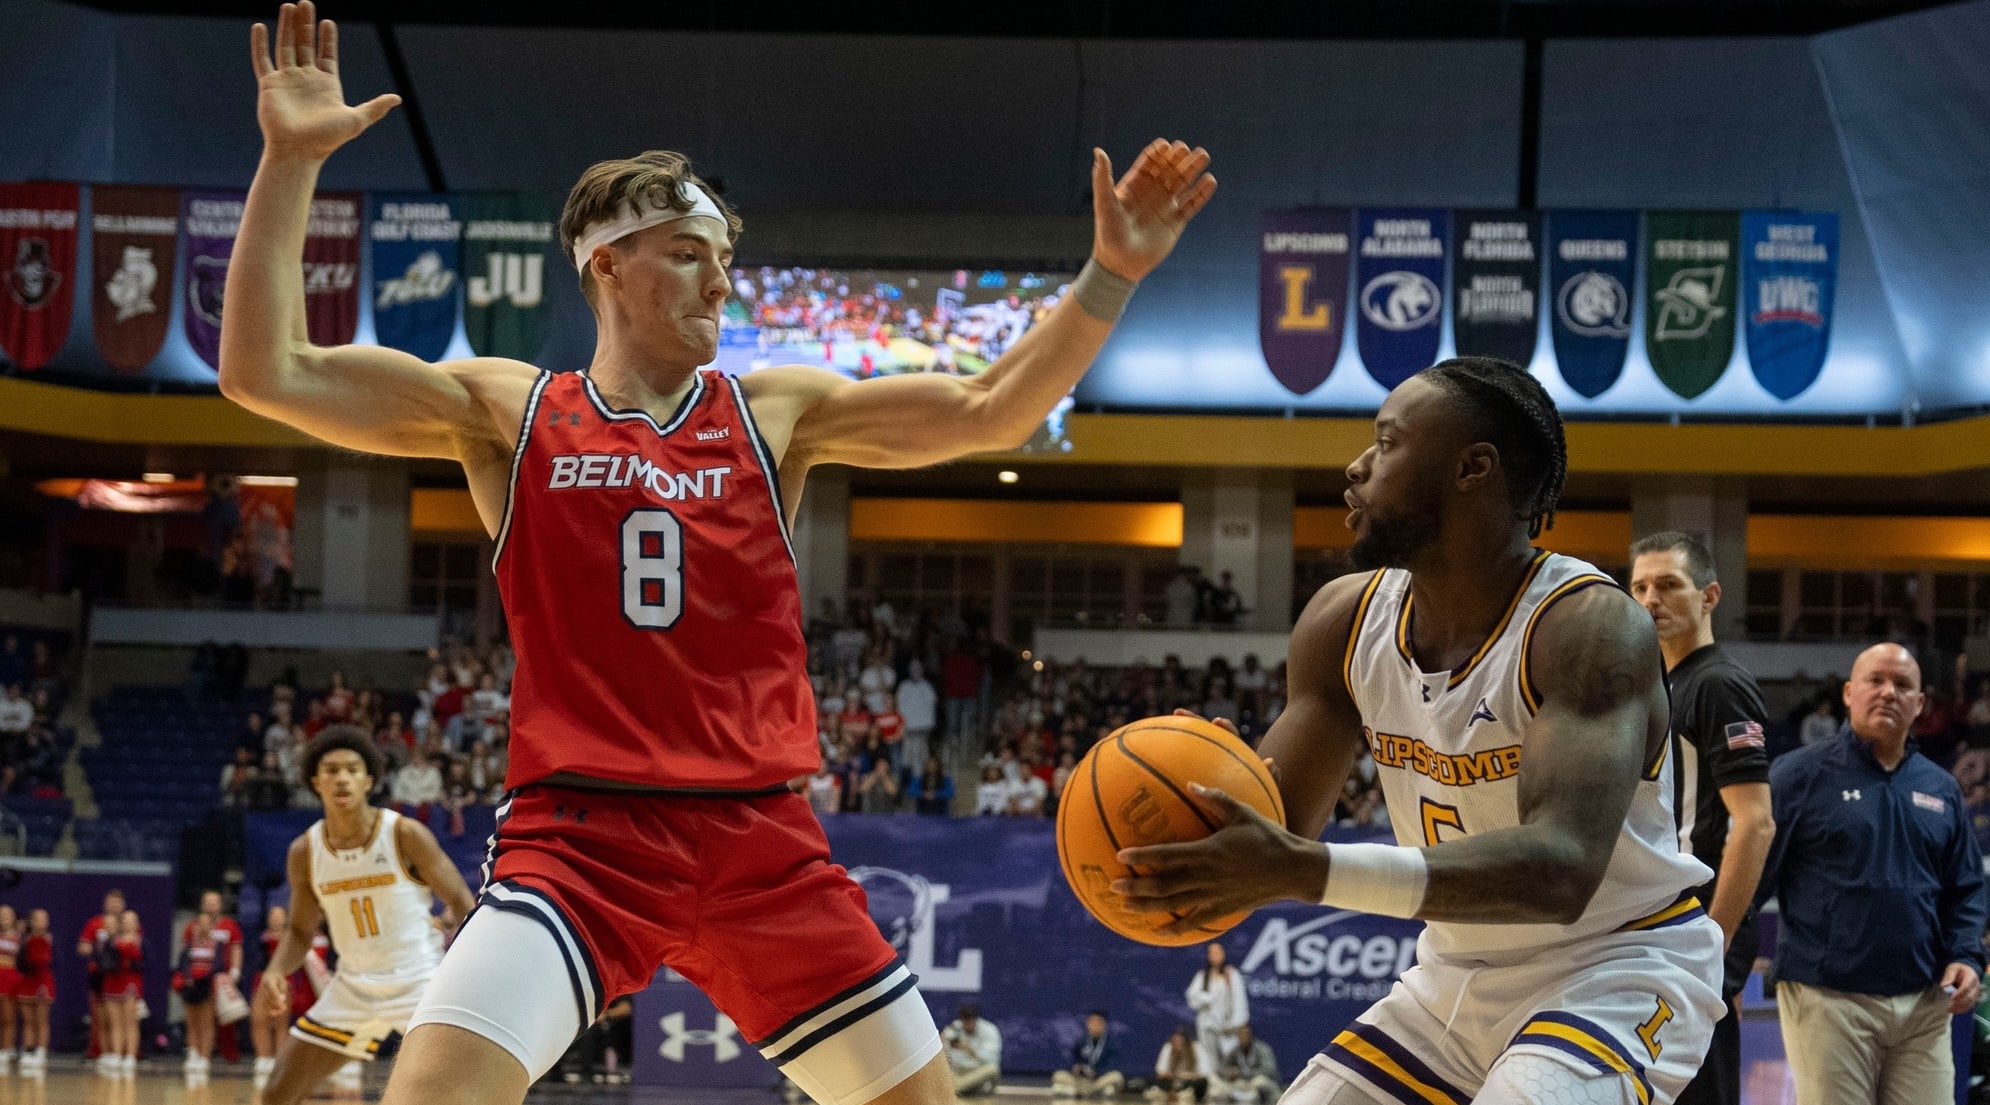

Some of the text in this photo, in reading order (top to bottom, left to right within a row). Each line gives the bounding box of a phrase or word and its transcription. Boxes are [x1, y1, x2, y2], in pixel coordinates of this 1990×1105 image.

[1373, 219, 1432, 237] NORTH
[1470, 222, 1528, 240] NORTH
[1263, 232, 1349, 253] LIPSCOMB
[1360, 237, 1443, 257] ALABAMA
[1462, 240, 1534, 260] FLORIDA
[1559, 239, 1627, 260] QUEENS
[468, 253, 544, 308] JU
[1277, 265, 1331, 332] L
[695, 426, 729, 441] VALLEY
[548, 453, 731, 501] BELMONT
[618, 507, 685, 630] 8
[1364, 726, 1522, 787] LIPSCOMB
[351, 895, 380, 938] 11
[1248, 977, 1321, 999] ederal
